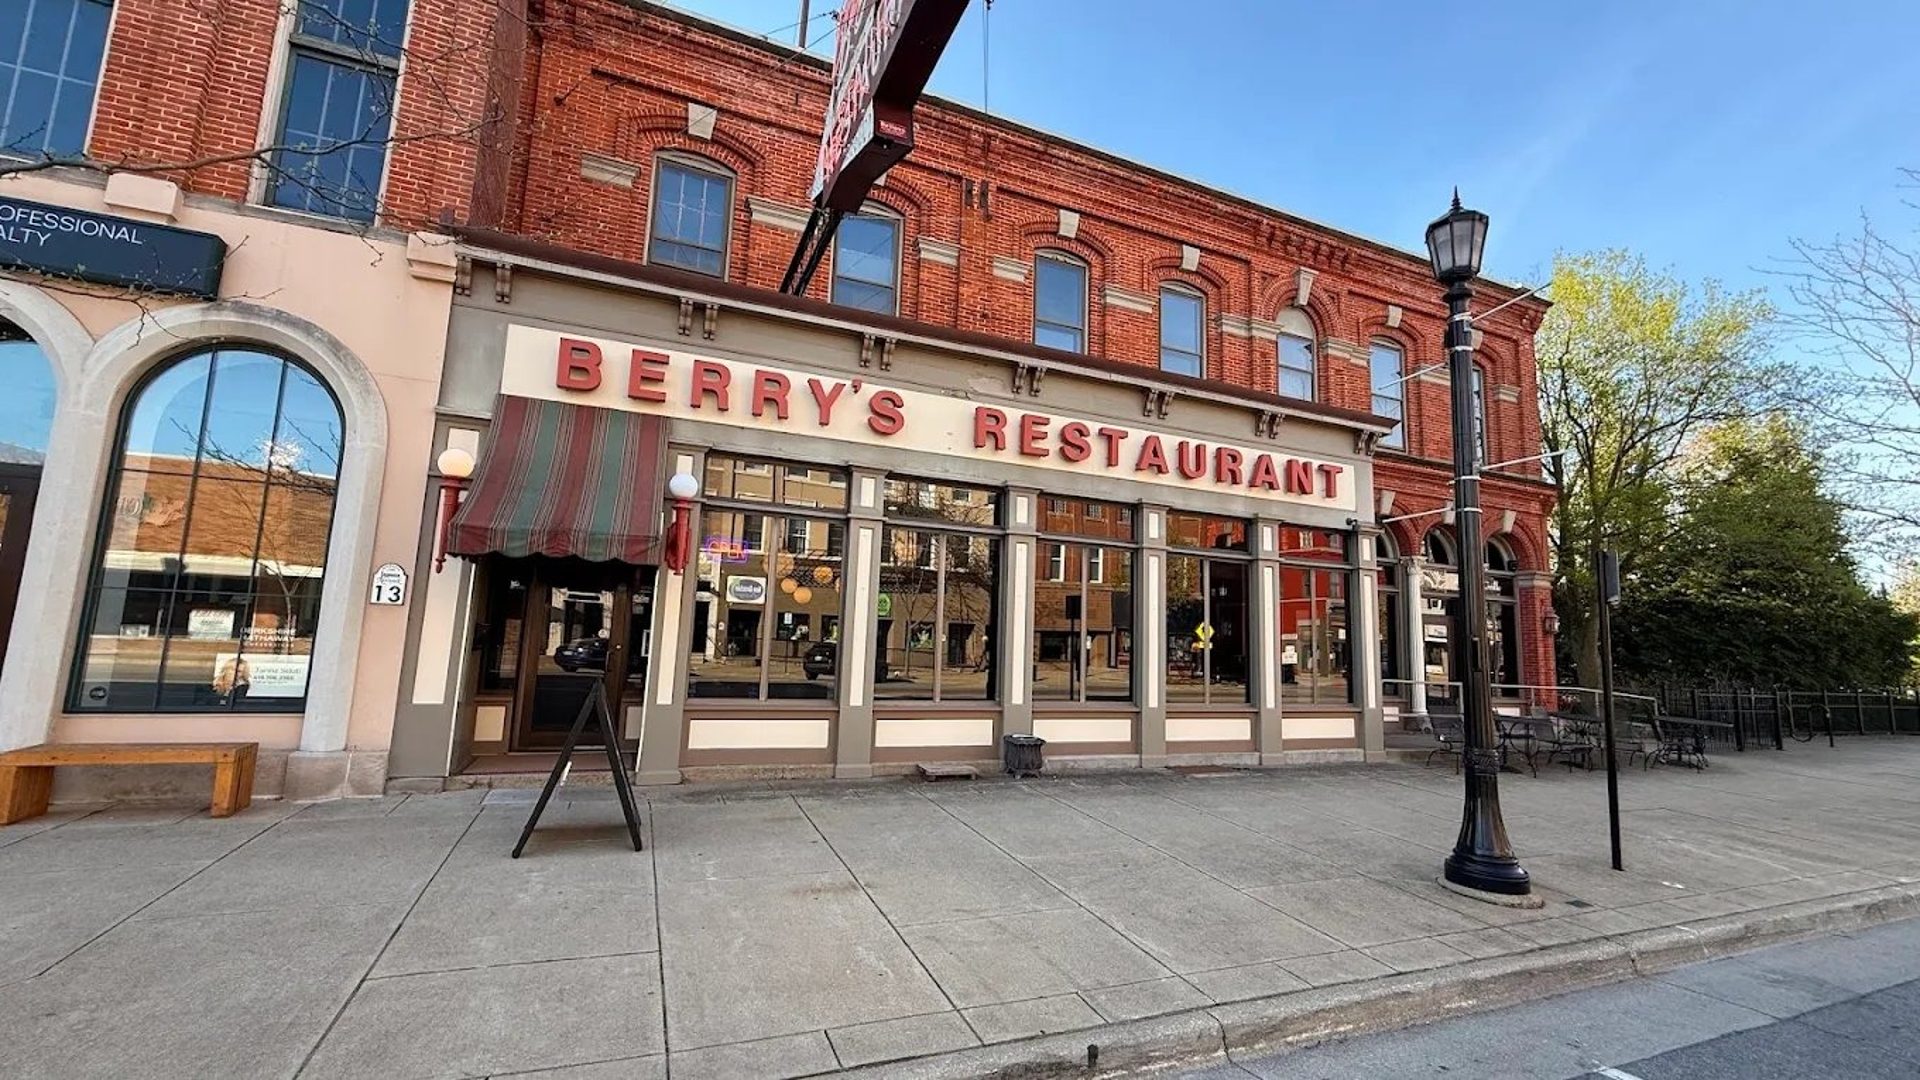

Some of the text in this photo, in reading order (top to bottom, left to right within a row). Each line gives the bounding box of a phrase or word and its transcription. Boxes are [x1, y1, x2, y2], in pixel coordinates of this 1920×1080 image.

[556, 337, 1343, 498] BERRY'S RESTAURANT
[376, 585, 401, 602] 13
